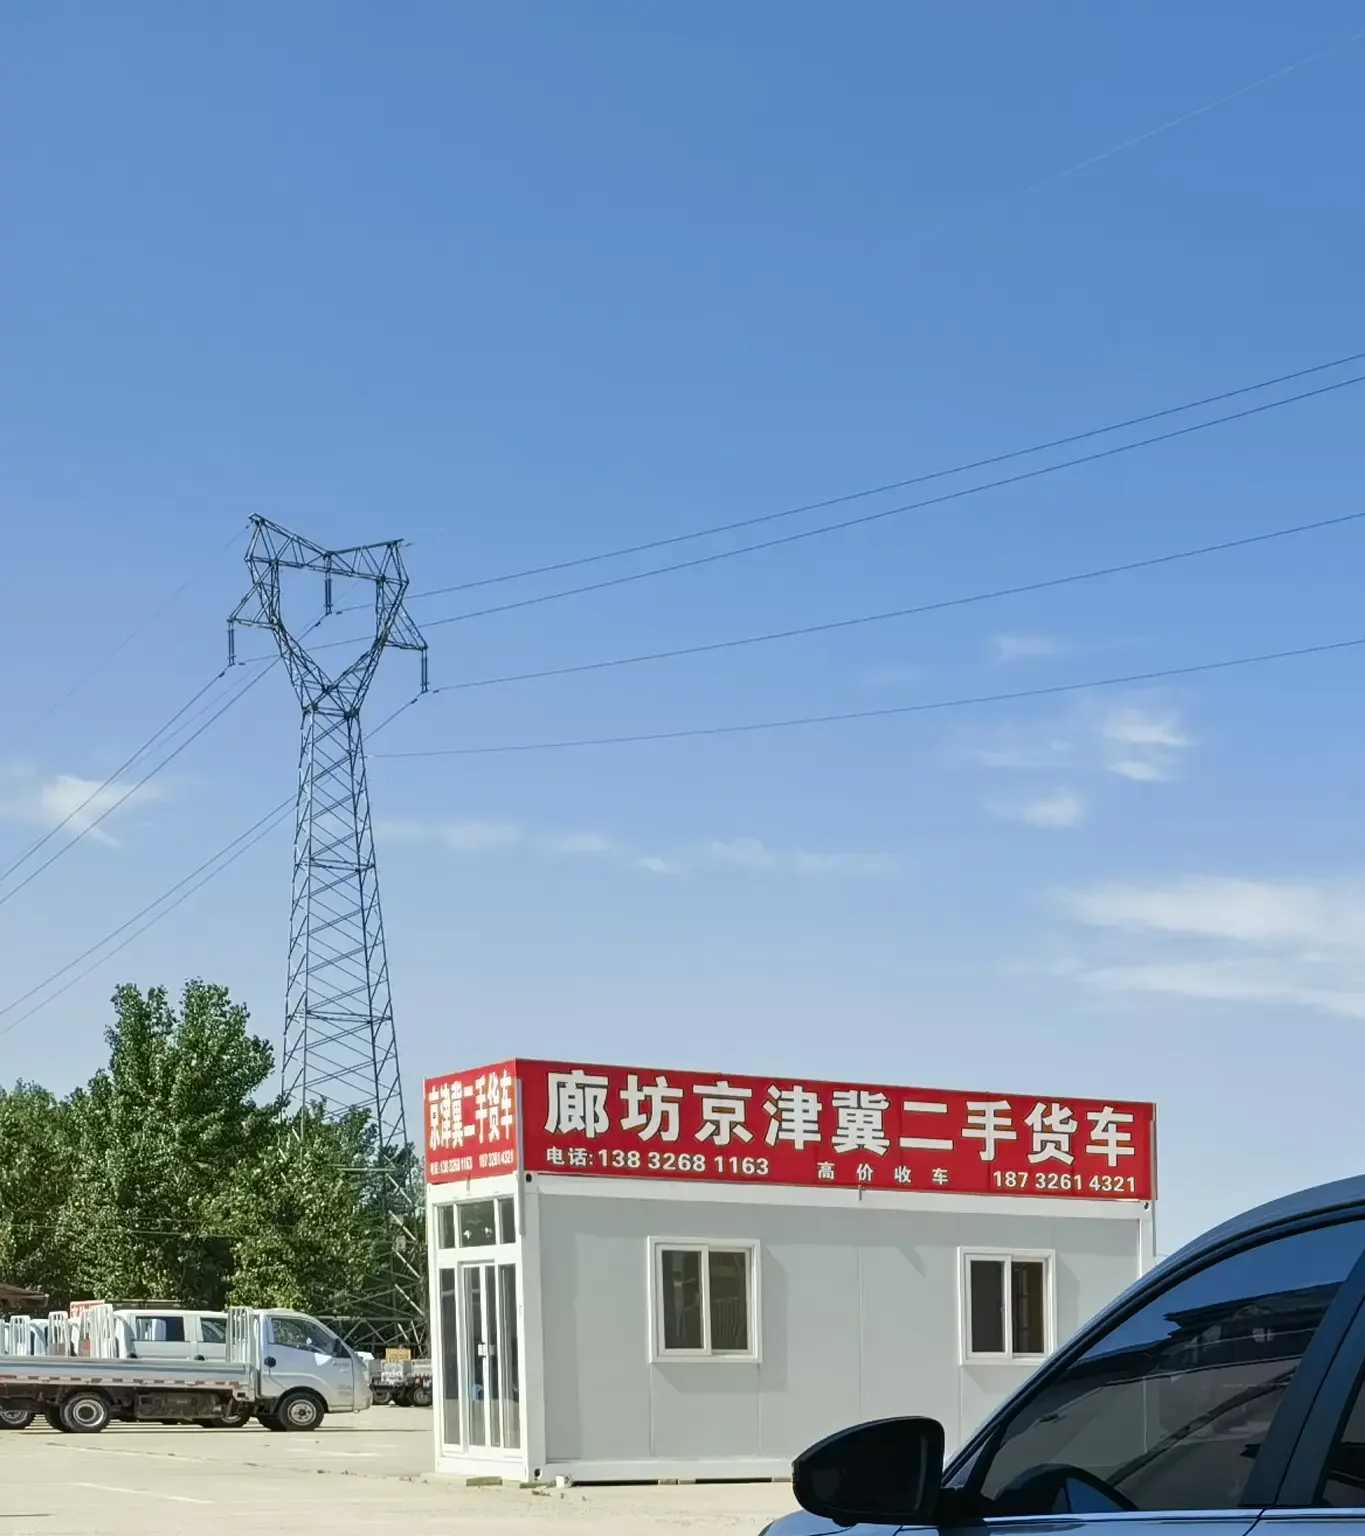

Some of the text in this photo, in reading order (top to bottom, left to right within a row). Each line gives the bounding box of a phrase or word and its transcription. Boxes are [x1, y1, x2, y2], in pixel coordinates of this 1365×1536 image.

[544, 1069, 1135, 1167] 廊坊京津冀二手货车
[648, 1151, 706, 1172] 3268
[714, 1155, 769, 1175] 1163
[993, 1171, 1136, 1192] 187 3261 4321
